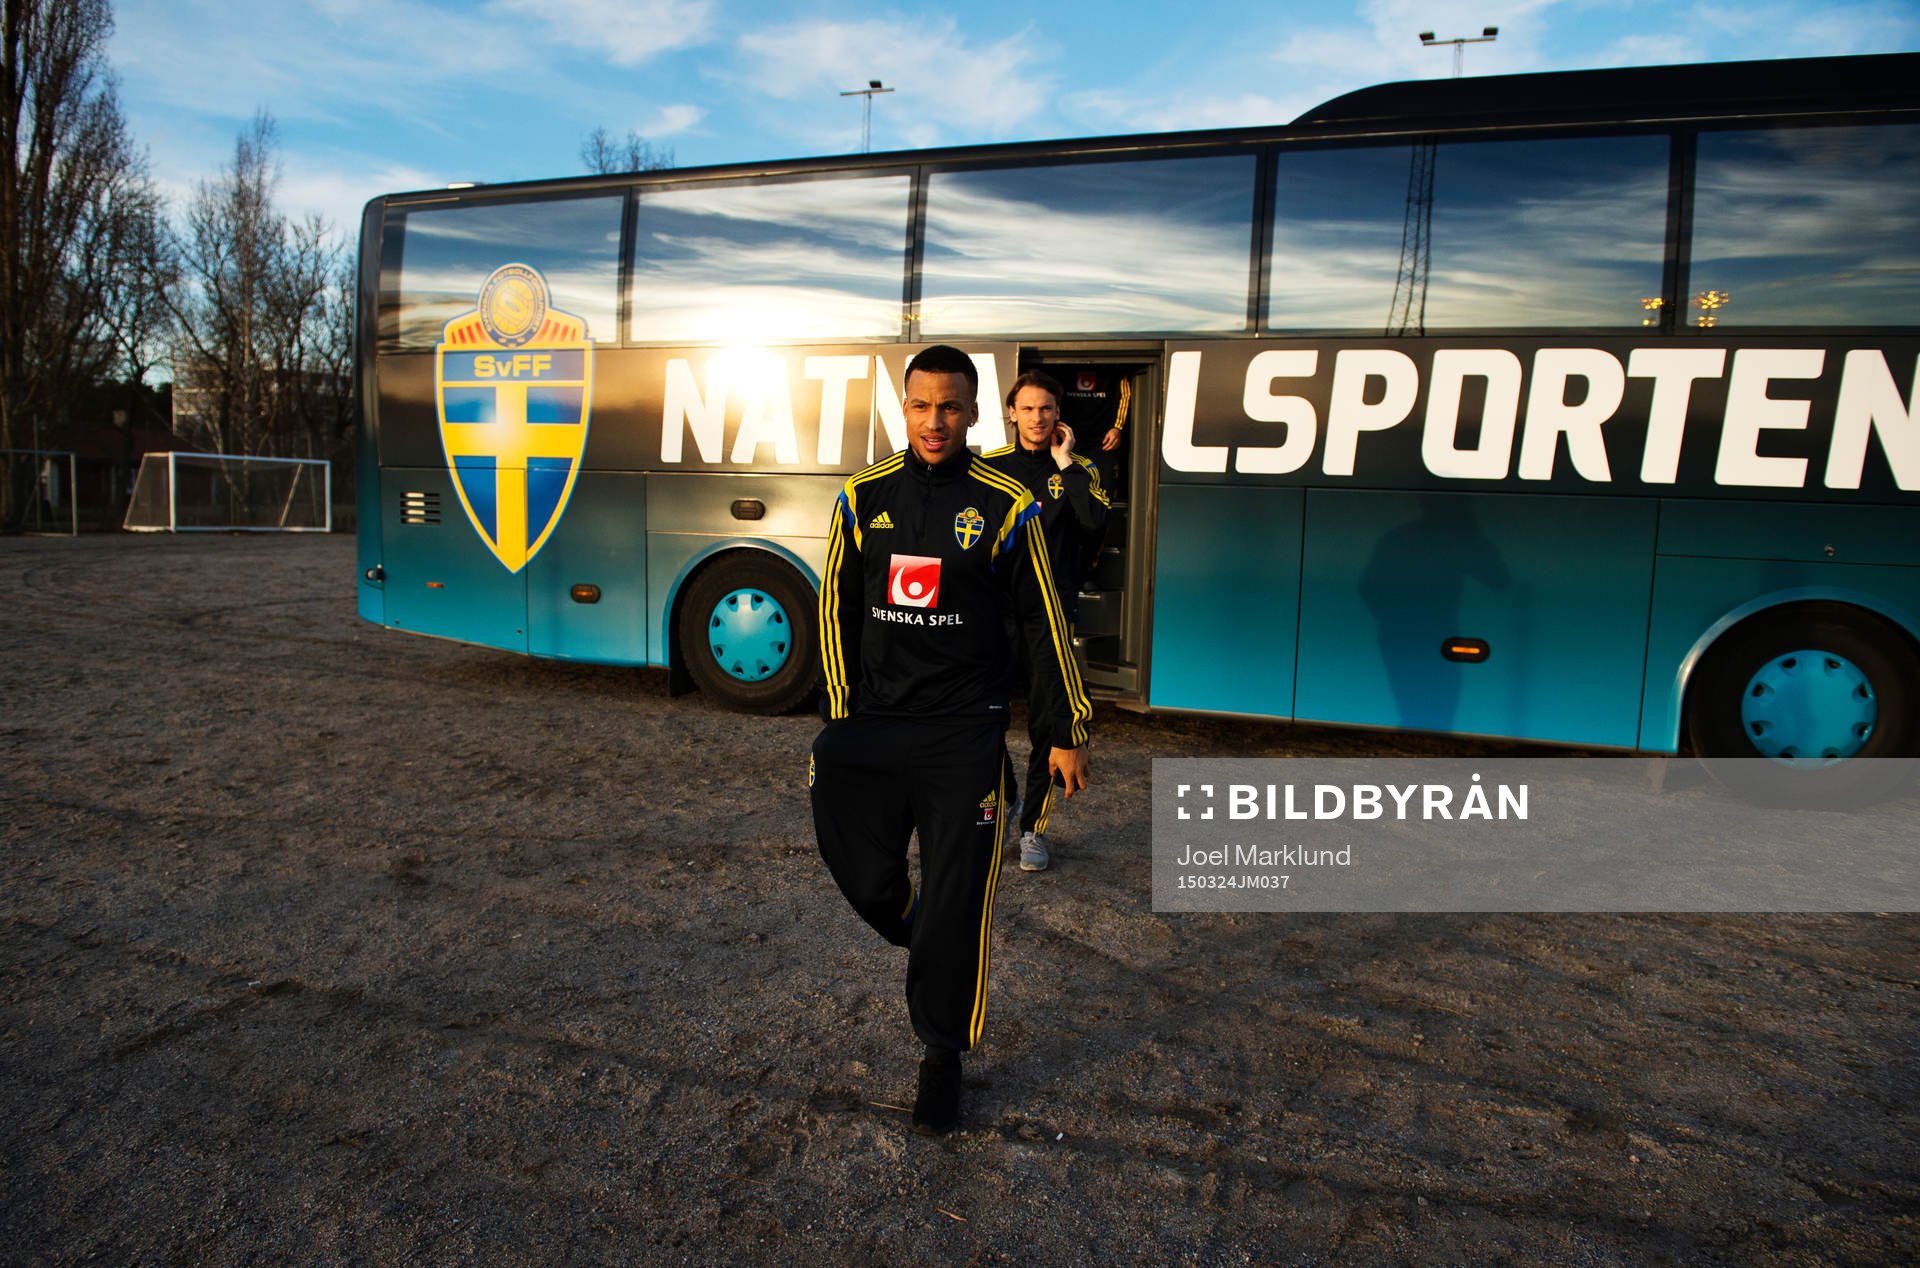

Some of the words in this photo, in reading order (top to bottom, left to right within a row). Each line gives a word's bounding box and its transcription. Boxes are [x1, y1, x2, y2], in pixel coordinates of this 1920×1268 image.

[473, 354, 552, 378] SvFF
[869, 521, 894, 529] adidas
[871, 606, 924, 626] SVENSKA
[928, 613, 963, 626] SPEL
